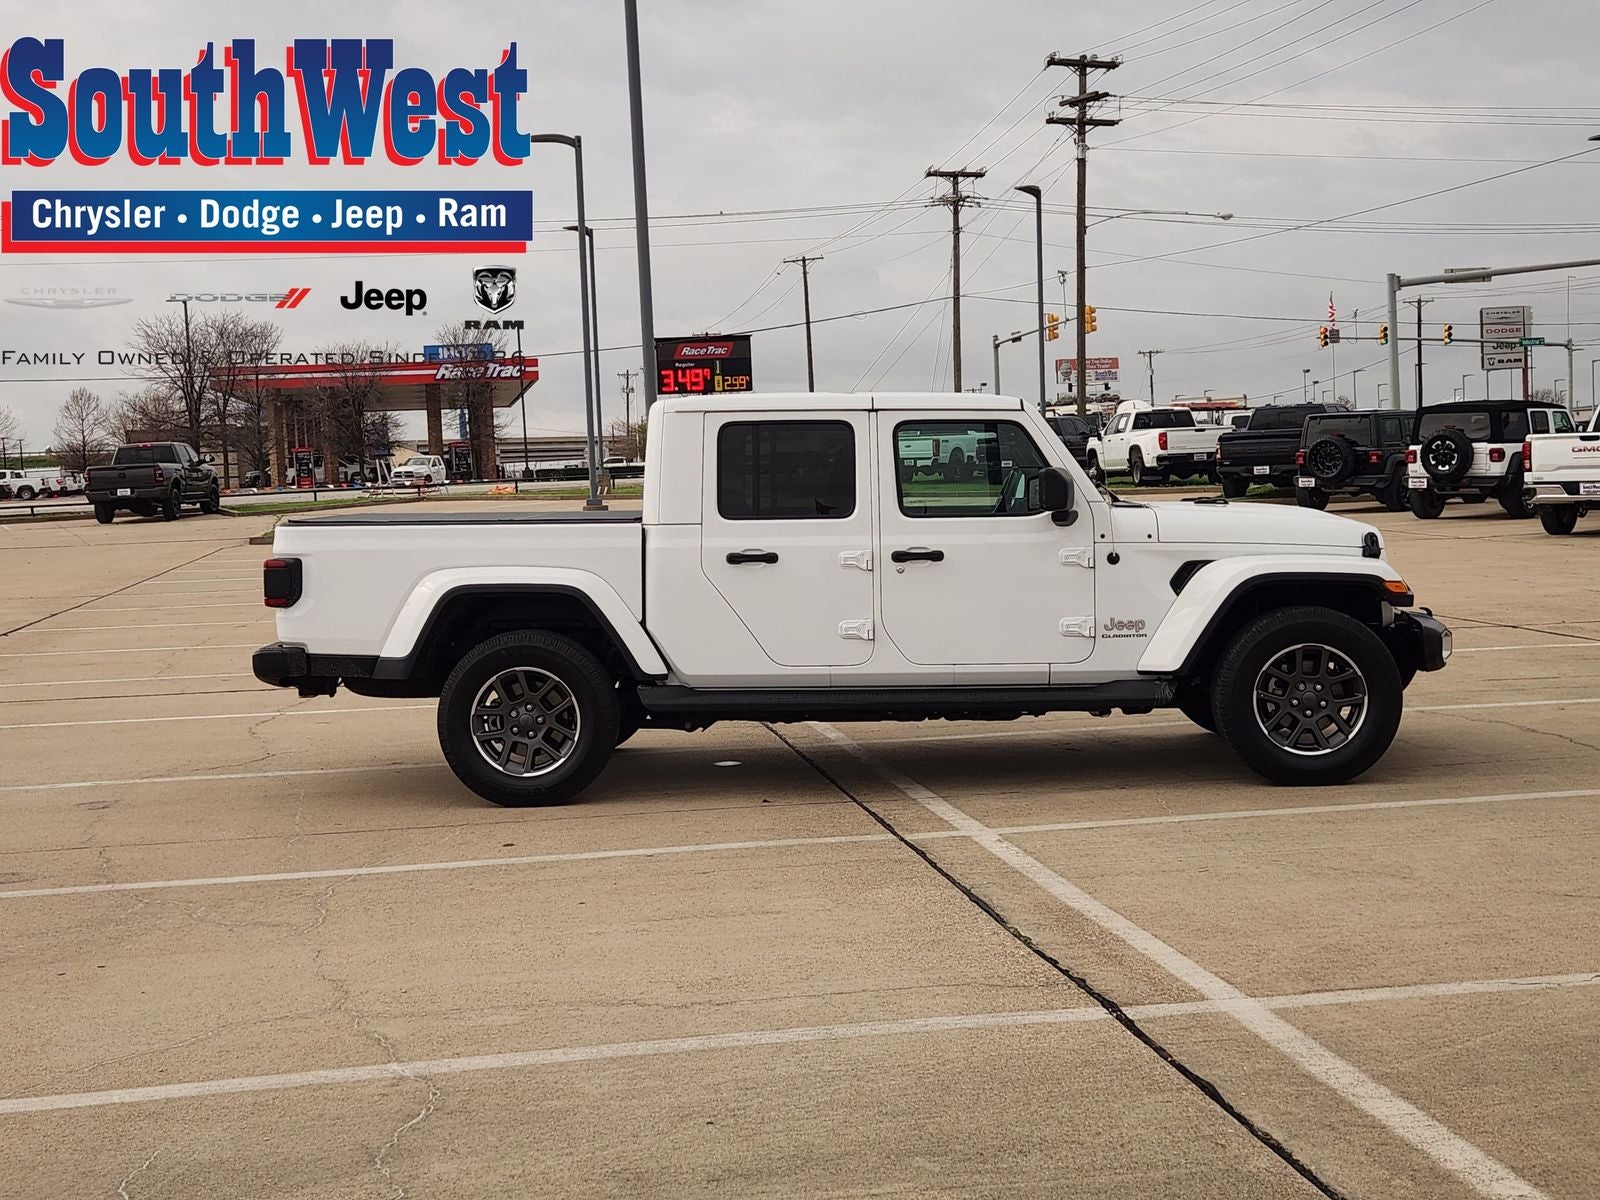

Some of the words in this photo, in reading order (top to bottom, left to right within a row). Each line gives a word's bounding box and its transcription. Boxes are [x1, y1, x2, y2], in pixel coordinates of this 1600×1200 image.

[1492, 341, 1517, 350] Jeep
[680, 346, 728, 356] RaceTrac
[1103, 617, 1146, 633] Jeep
